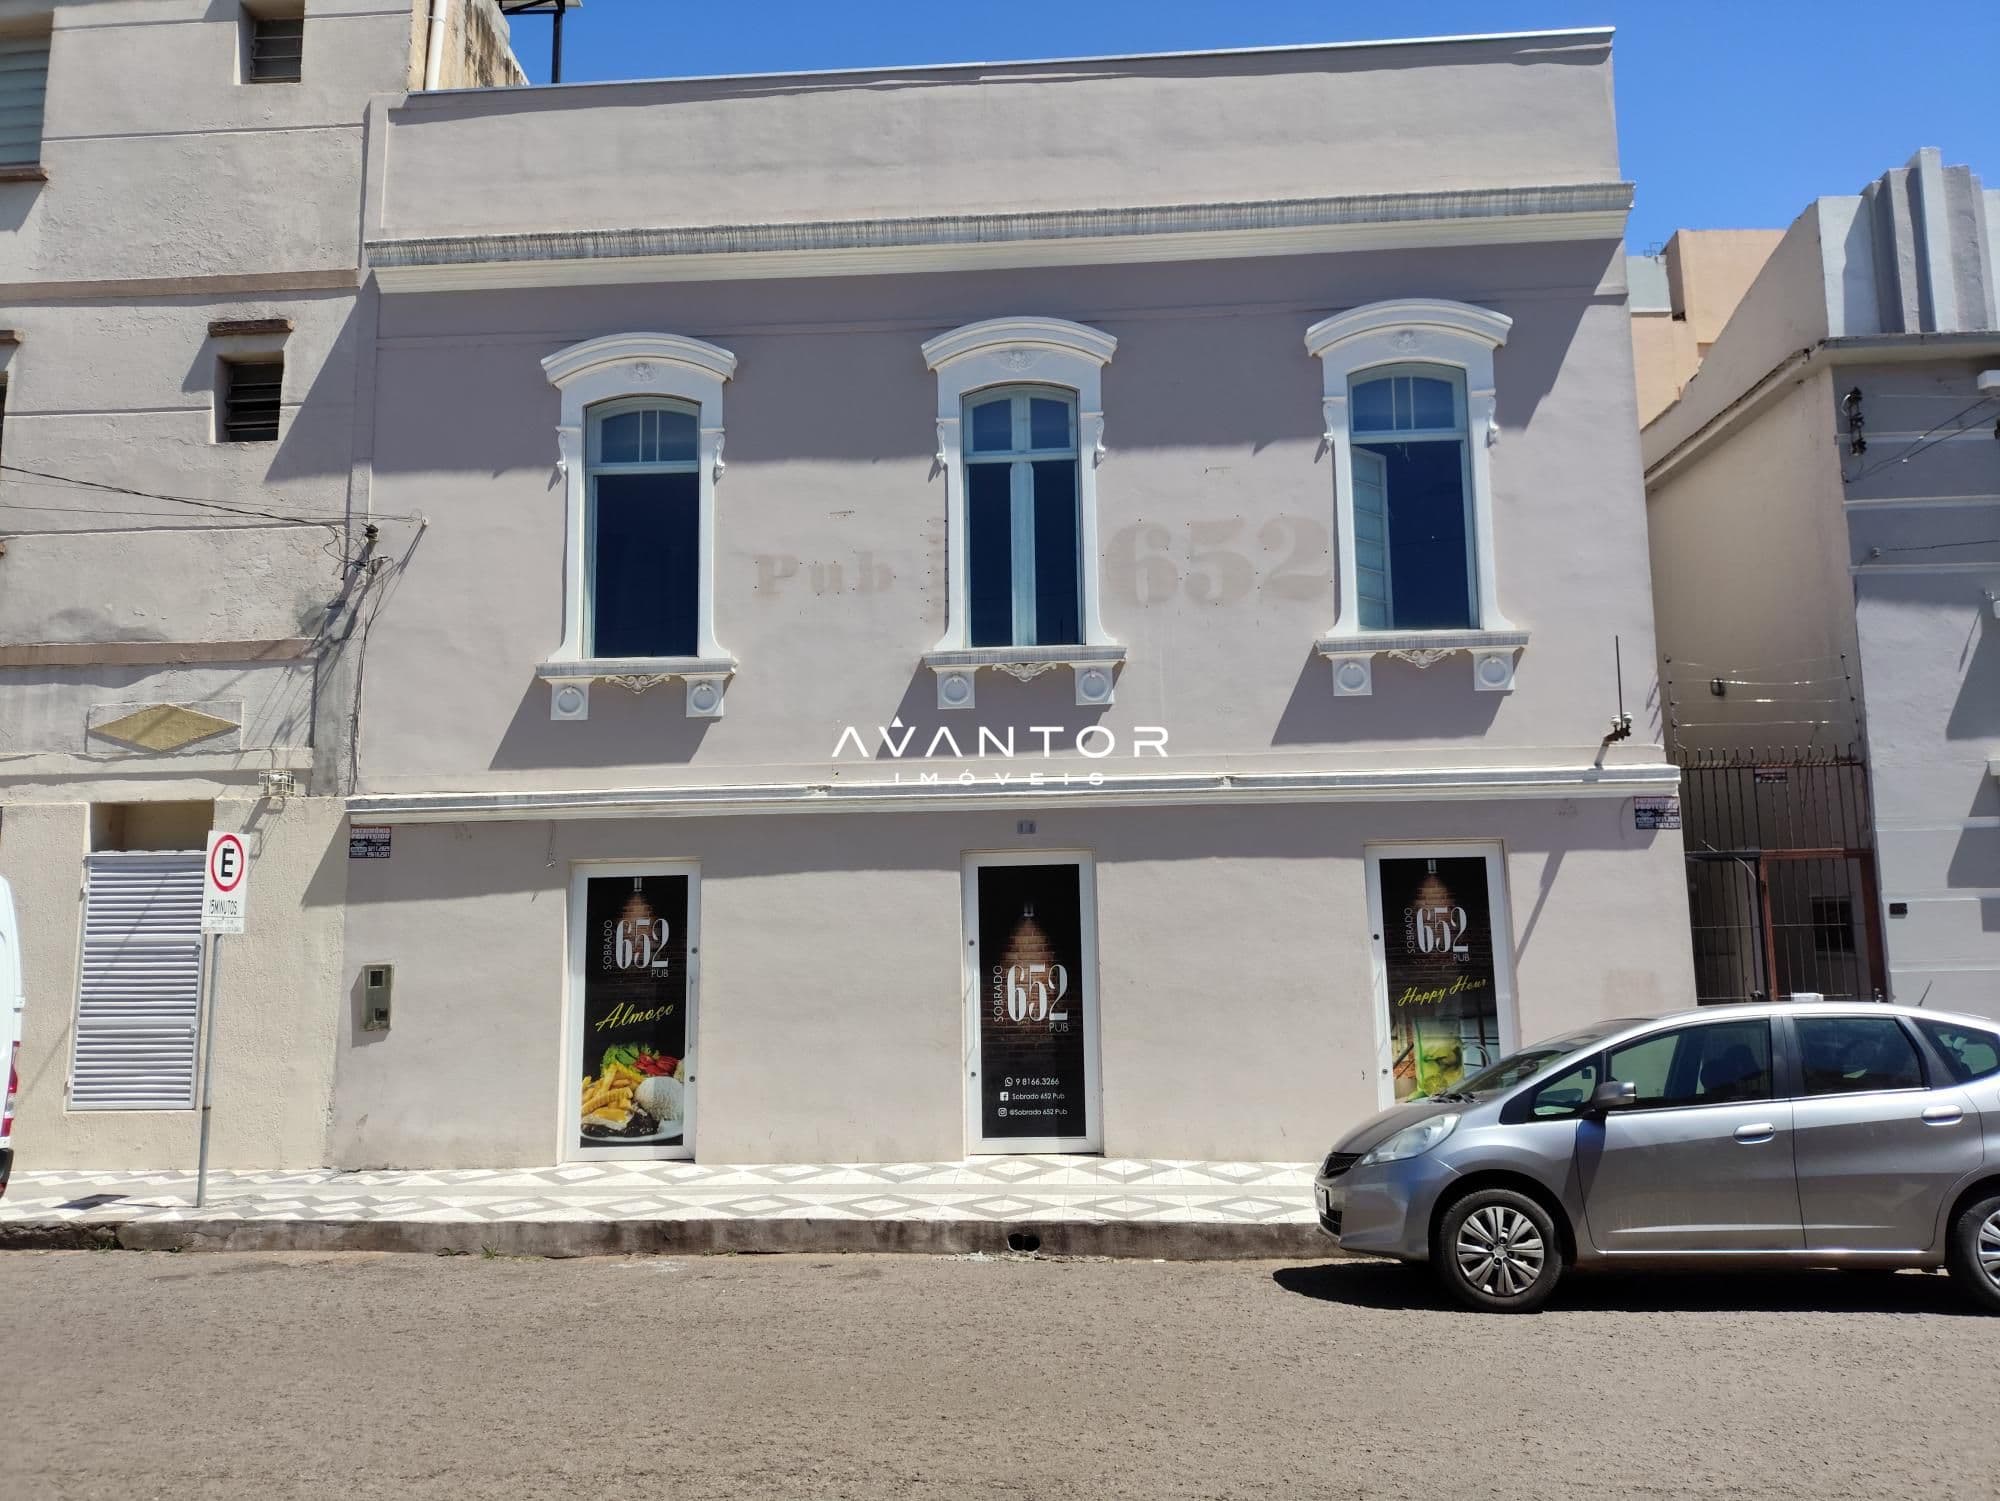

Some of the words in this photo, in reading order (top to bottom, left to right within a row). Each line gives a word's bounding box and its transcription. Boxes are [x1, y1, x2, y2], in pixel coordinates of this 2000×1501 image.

[1105, 515, 1329, 604] 652
[221, 848, 235, 878] E
[603, 919, 613, 970] SOBRADO
[615, 918, 669, 969] 652
[1404, 907, 1416, 954] SOBRADO
[1416, 906, 1469, 953] 652
[1453, 953, 1470, 962] PUB
[651, 969, 669, 978] PUB
[993, 965, 1004, 1023] SOBRADO
[1007, 963, 1068, 1021] 652
[1397, 985, 1446, 1007] Happy
[1449, 976, 1487, 995] Hour
[595, 1002, 674, 1032] Almoço
[1049, 1023, 1069, 1033] PUB
[1012, 1092, 1039, 1100] Sobrado
[1040, 1092, 1052, 1100] 652
[1052, 1092, 1065, 1100] Pub
[1015, 1077, 1021, 1086] 9
